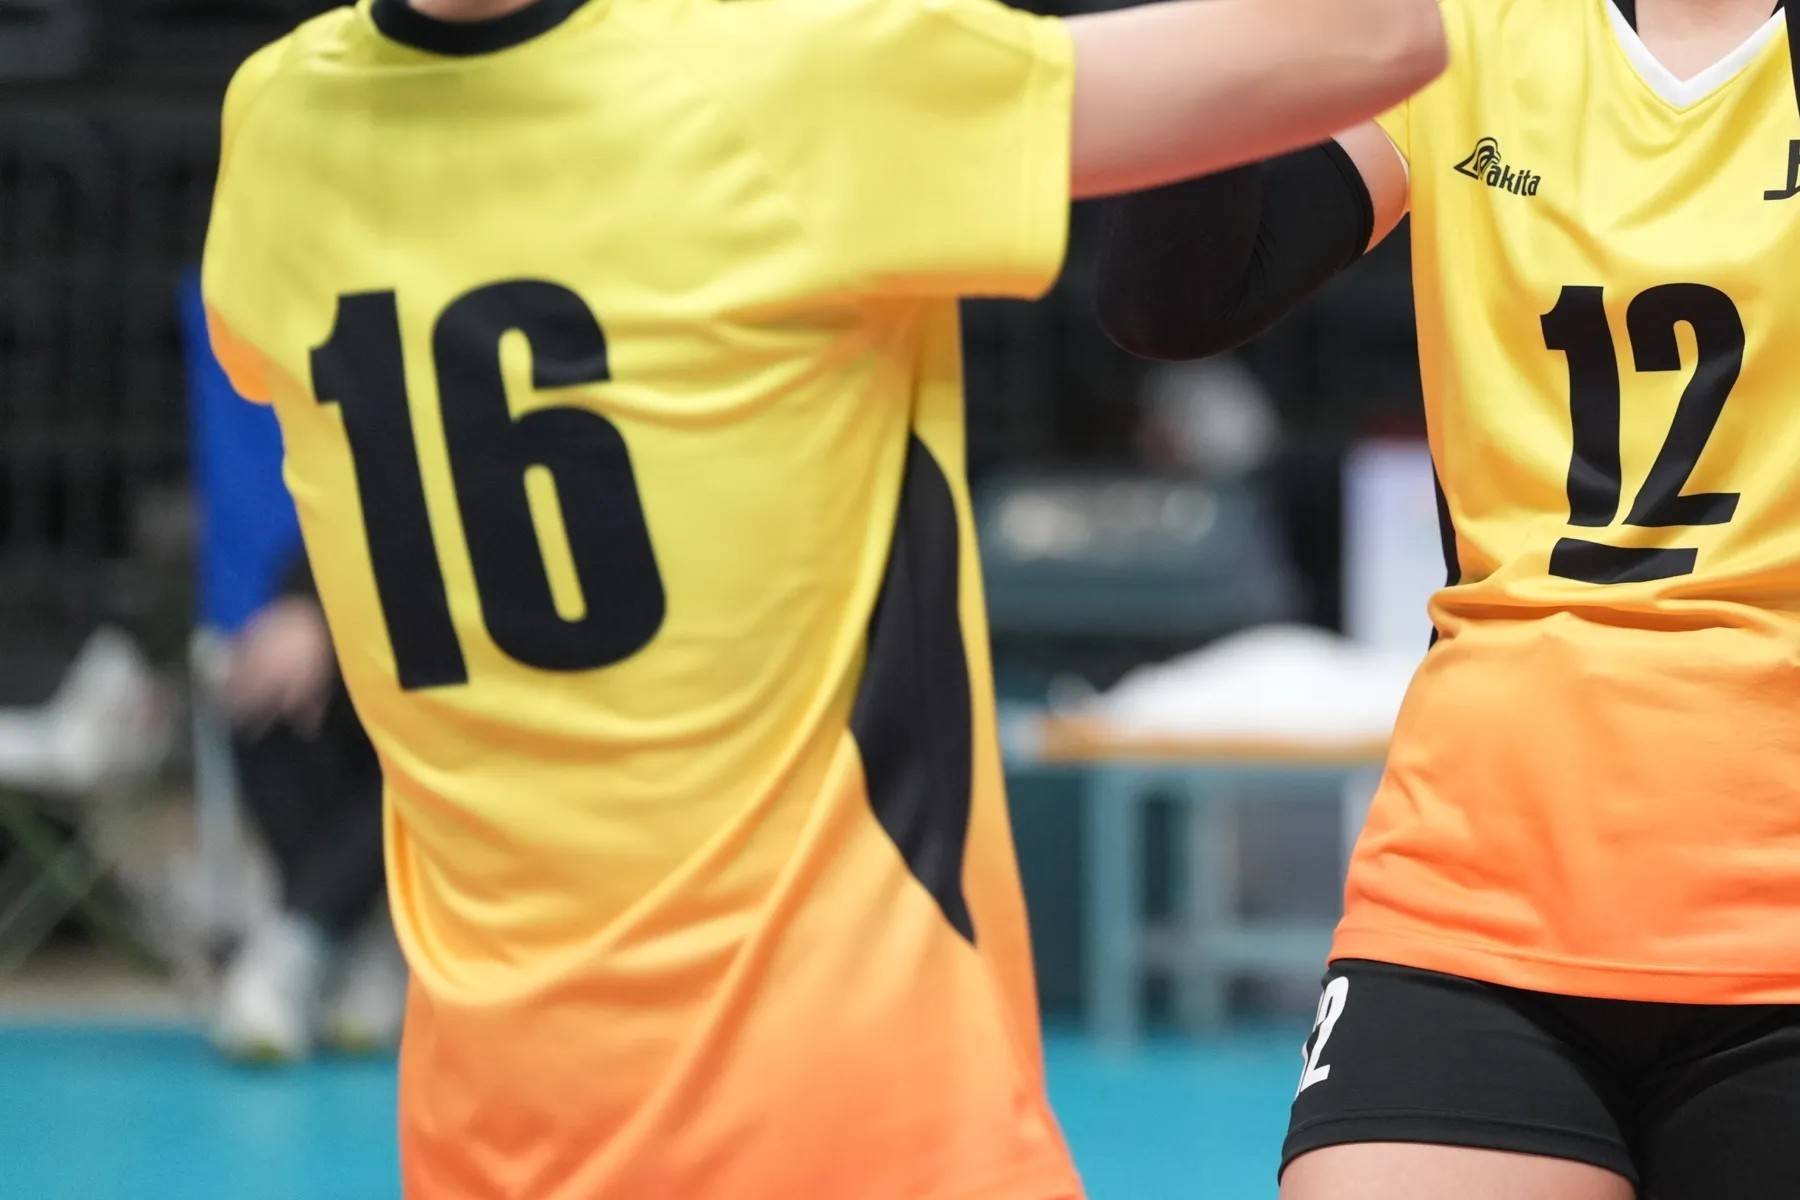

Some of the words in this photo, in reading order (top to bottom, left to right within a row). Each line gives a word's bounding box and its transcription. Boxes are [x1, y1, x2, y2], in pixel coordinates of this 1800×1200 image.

[1486, 164, 1542, 196] akita
[309, 278, 668, 693] 16
[1540, 282, 1746, 528] 12
[1296, 976, 1349, 1100] 2
